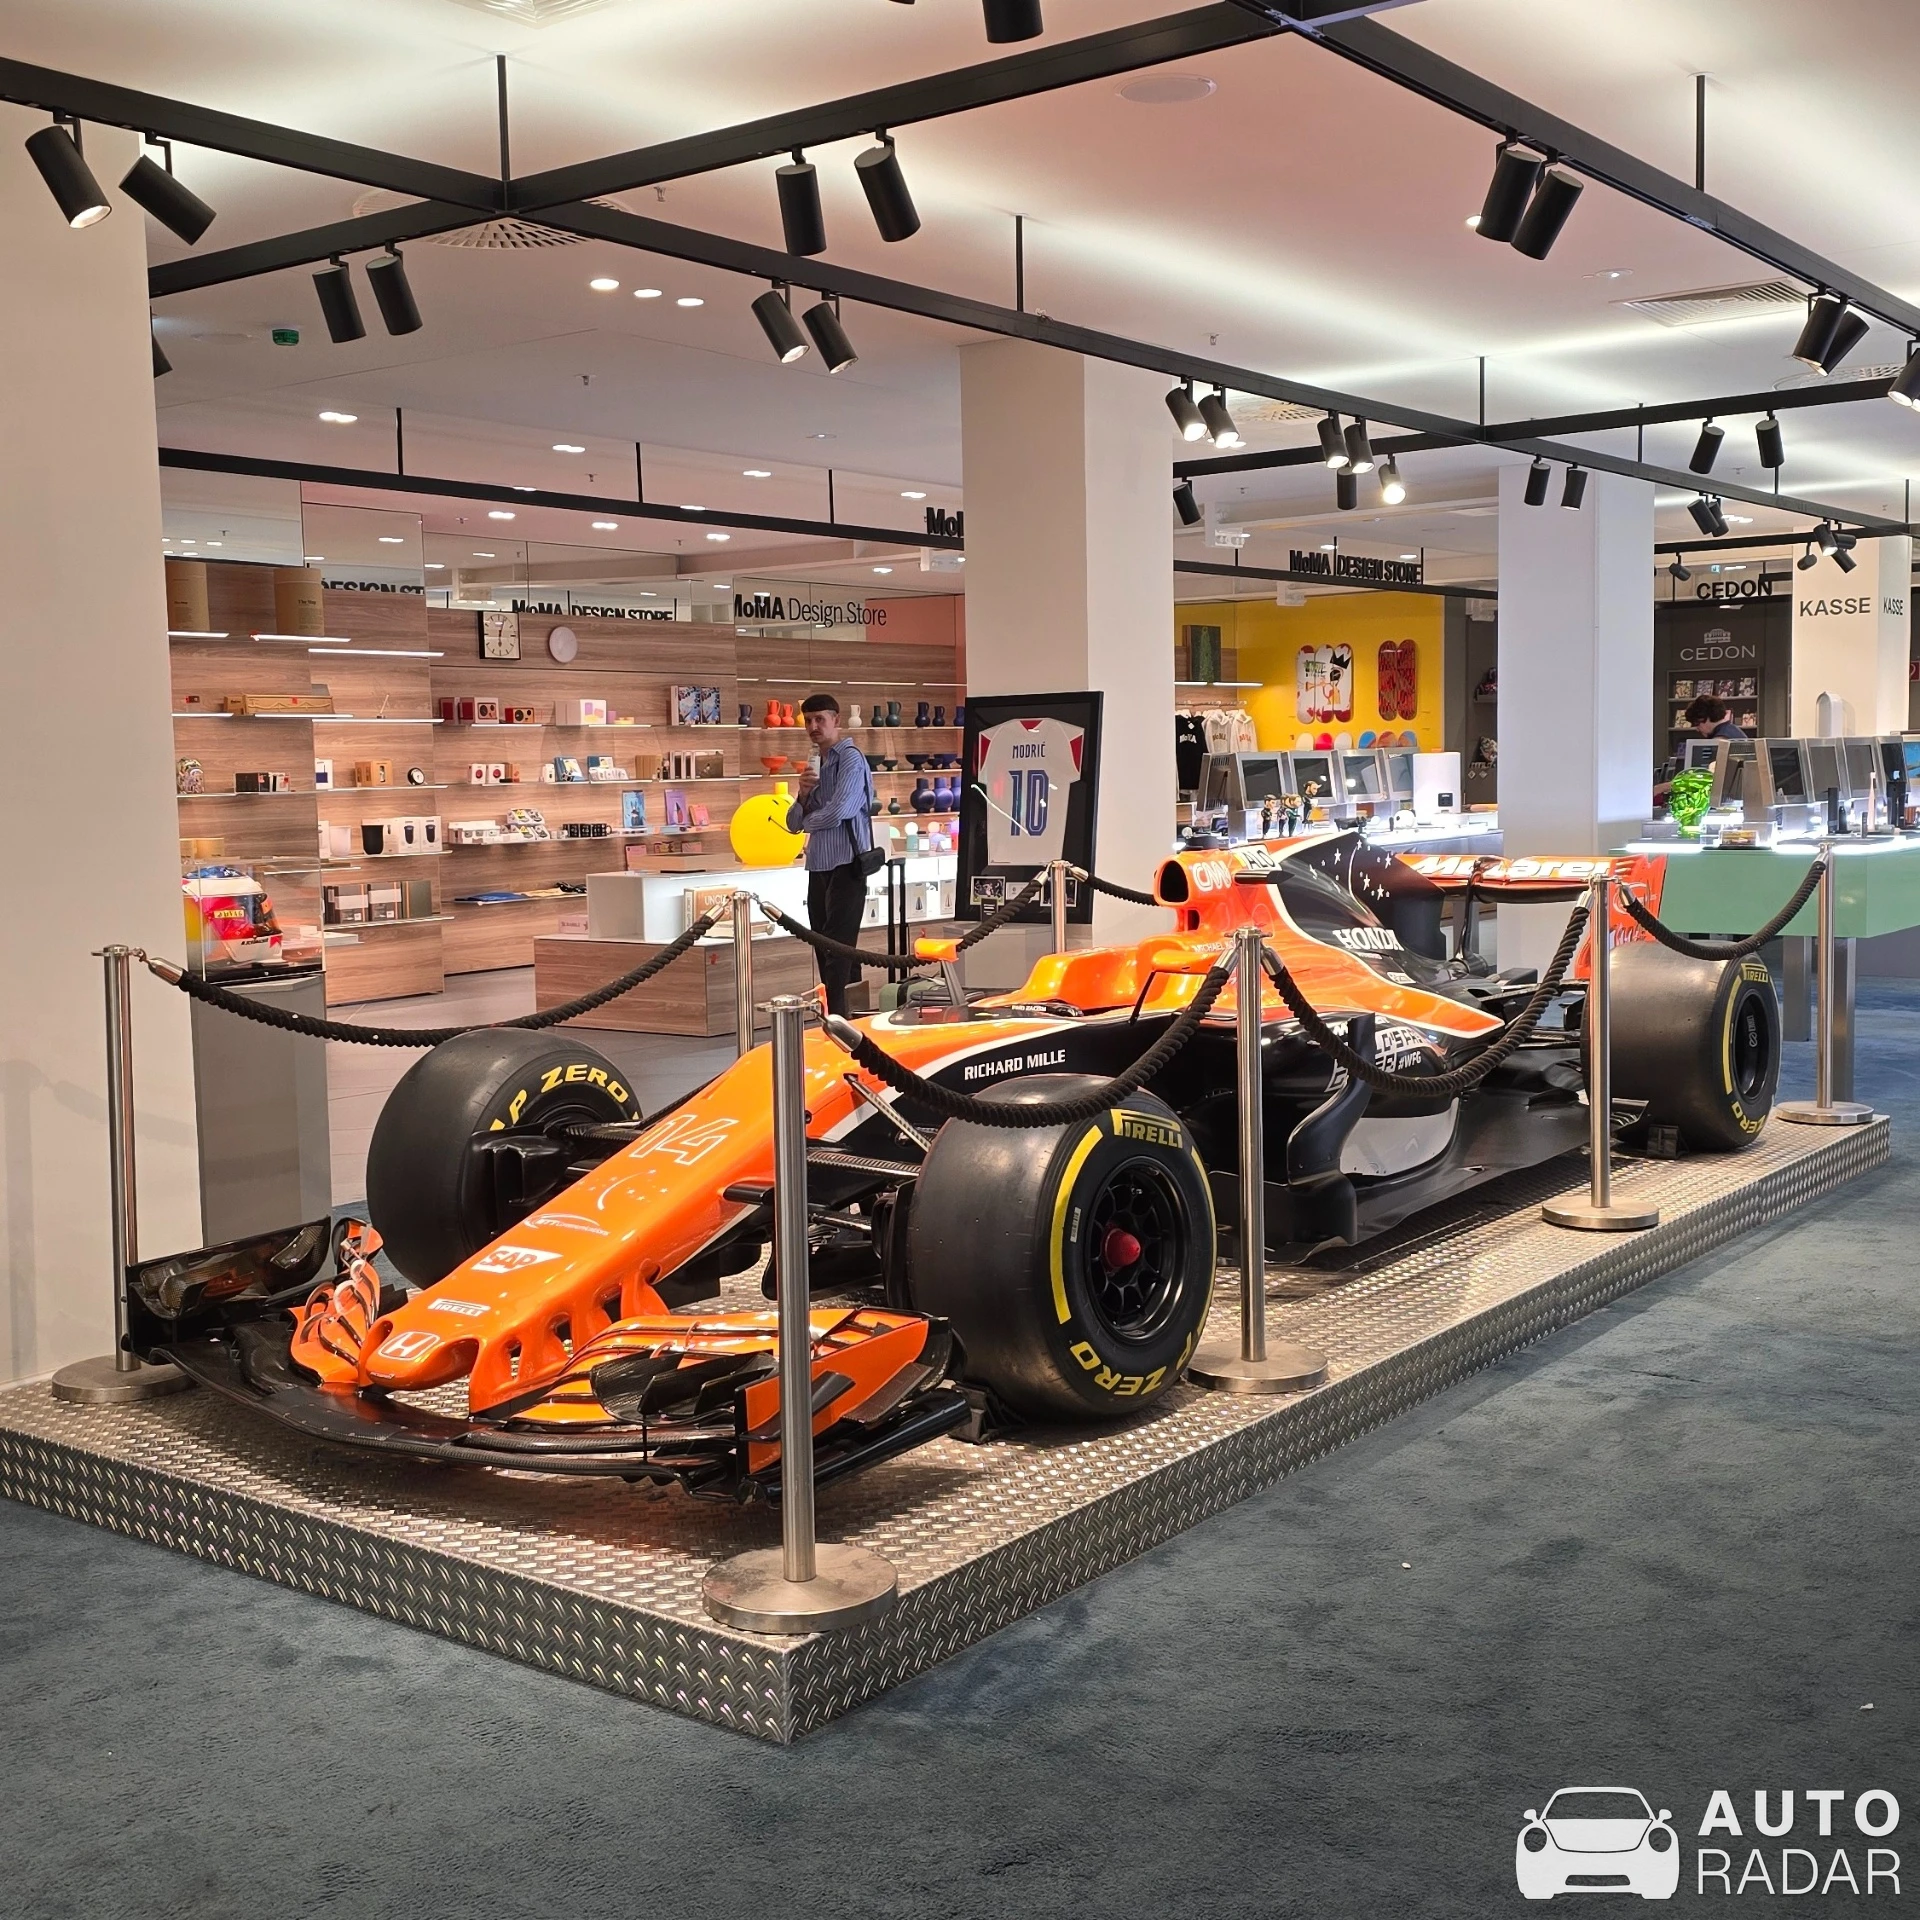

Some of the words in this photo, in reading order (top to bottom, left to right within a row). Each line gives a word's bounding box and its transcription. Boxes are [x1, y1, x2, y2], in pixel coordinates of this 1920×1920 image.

[1289, 550, 1332, 576] MoMA
[1337, 555, 1384, 580] DESIGN
[1384, 560, 1422, 584] STORE
[1696, 580, 1773, 600] CEDON
[789, 598, 843, 628] Design
[847, 602, 887, 626] Store
[1799, 597, 1871, 617] KASSE
[1883, 597, 1904, 616] KASSE
[1680, 645, 1756, 661] CEDON
[1012, 741, 1046, 759] MODRIĆ
[1008, 769, 1049, 836] 10
[1192, 860, 1232, 892] CNN
[1332, 927, 1405, 952] HONDA
[1741, 963, 1769, 983] PIRELLI
[964, 1056, 1023, 1080] RICHARD
[1027, 1049, 1066, 1069] MILLE
[509, 1089, 527, 1125] P
[541, 1064, 629, 1103] ZERO
[1110, 1109, 1183, 1148] PIRELLI
[1732, 1101, 1767, 1133] ZERO
[629, 1114, 740, 1166] 14
[480, 1250, 538, 1270] SAP
[428, 1298, 491, 1317] PIRELLI
[1070, 1341, 1167, 1396] ZERO
